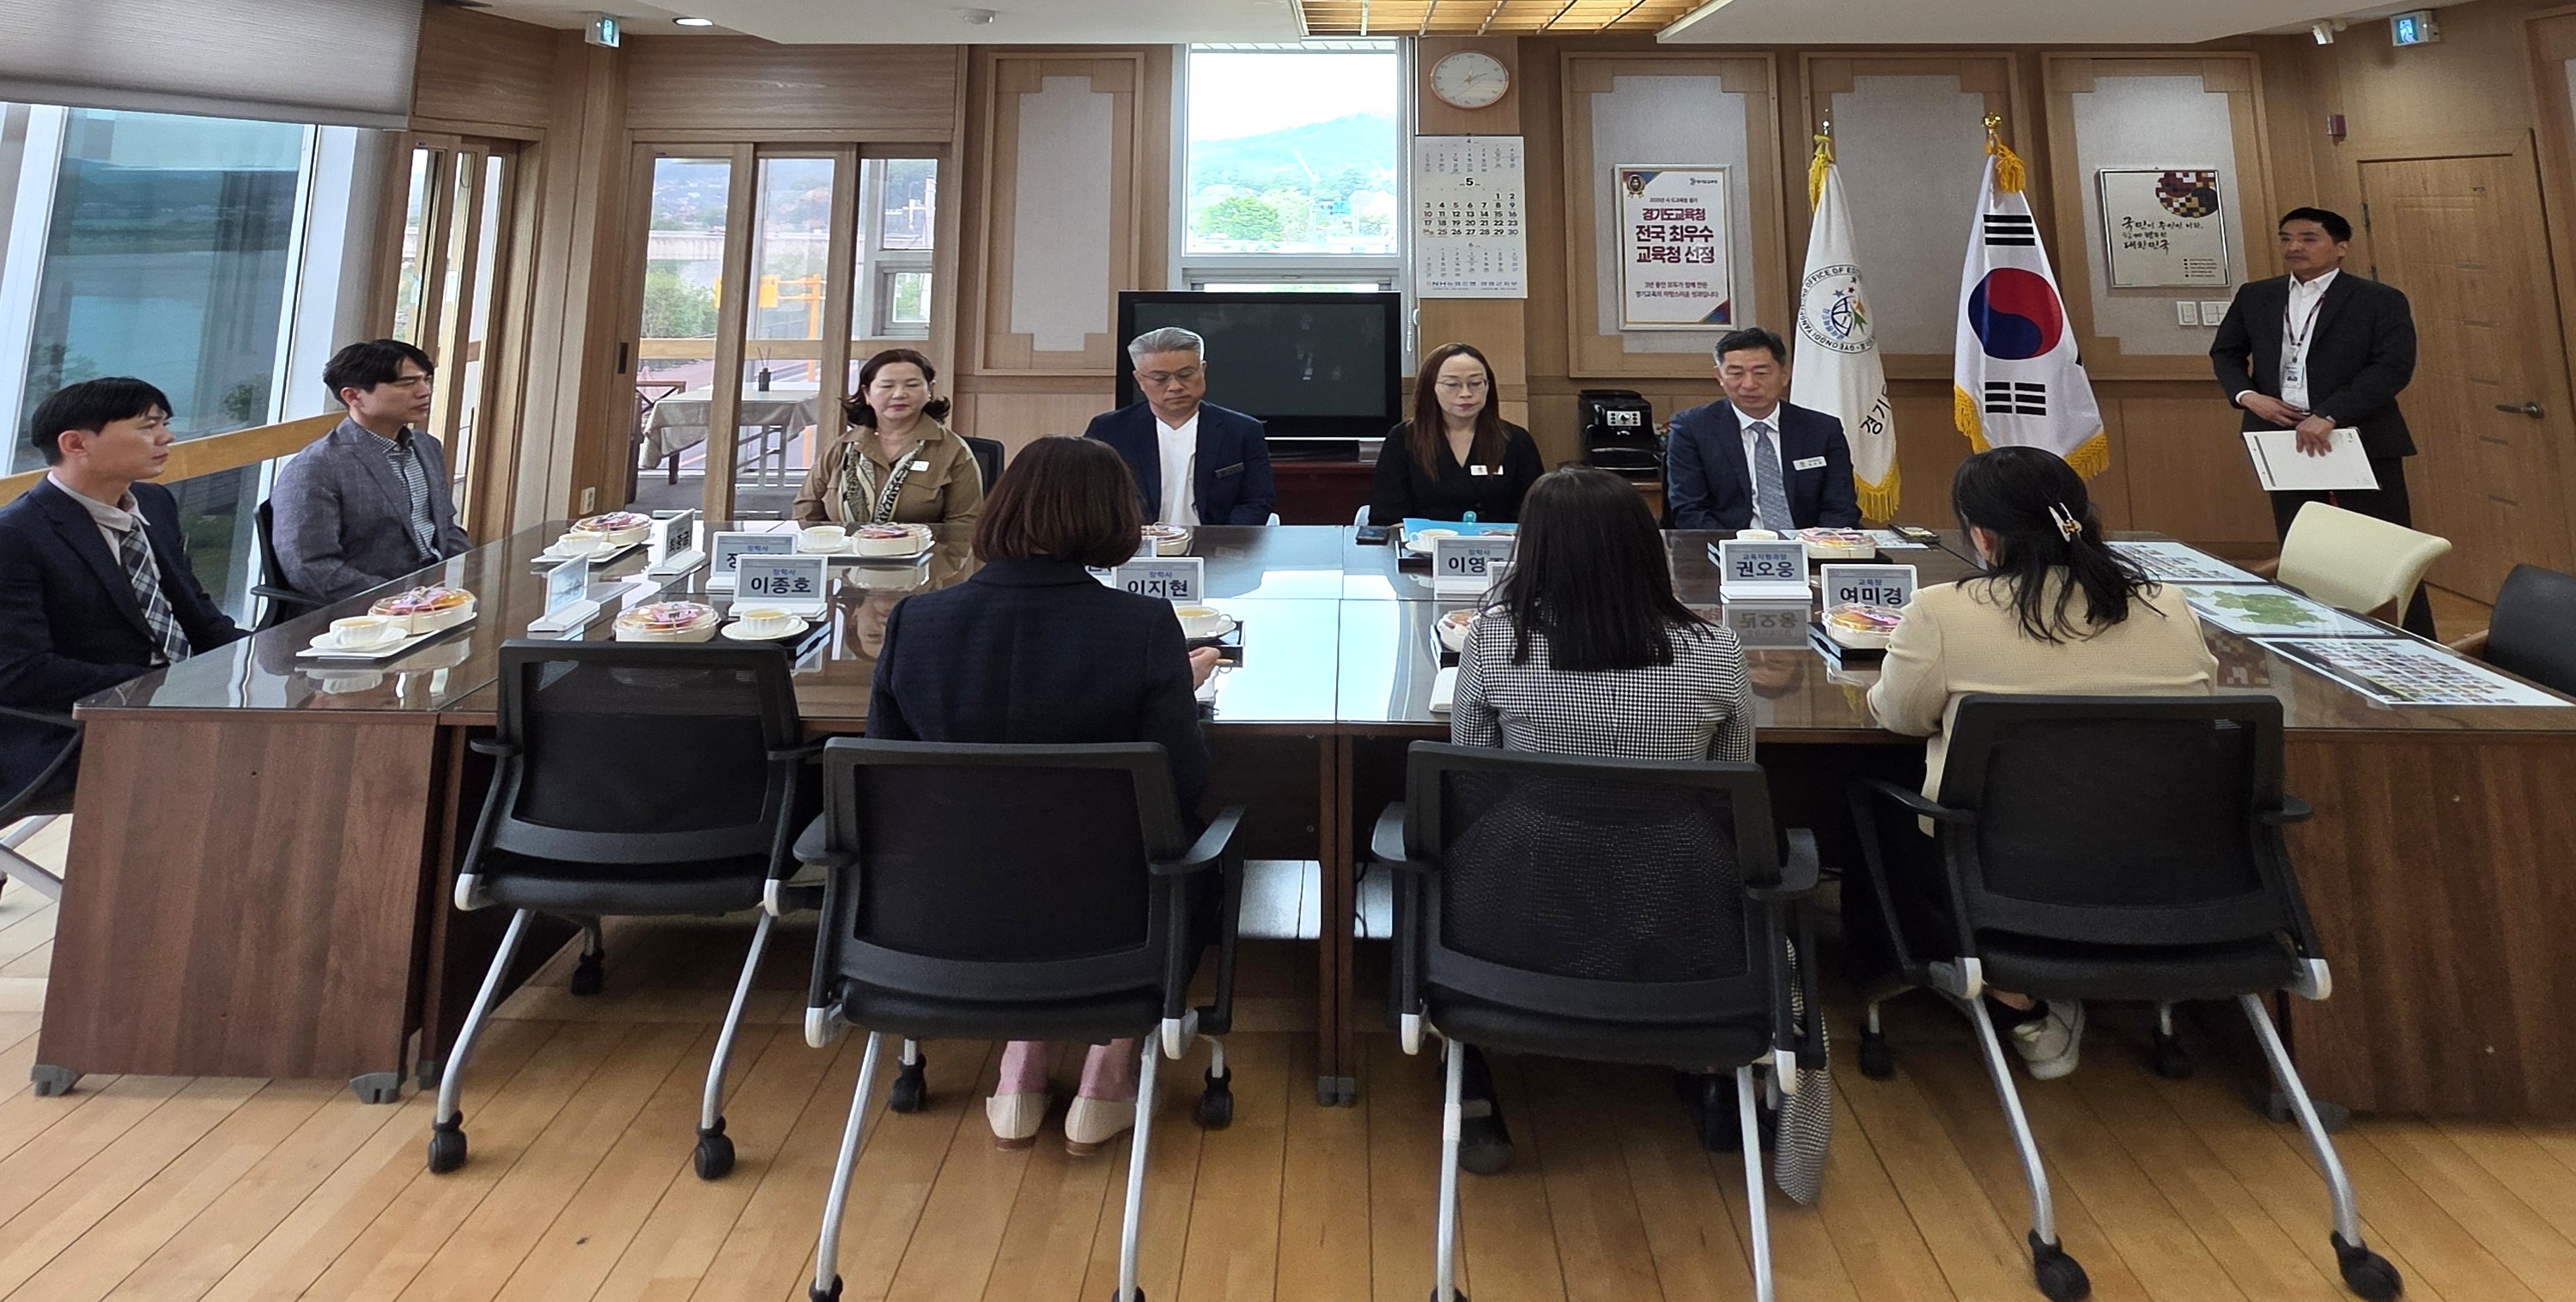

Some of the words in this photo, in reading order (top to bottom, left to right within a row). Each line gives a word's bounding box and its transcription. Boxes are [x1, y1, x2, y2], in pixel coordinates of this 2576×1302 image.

[1643, 208, 1705, 221] 경기도교육청
[2122, 216, 2154, 232] 국민이
[1636, 225, 1665, 242] 전국
[1669, 225, 1714, 242] 최우수
[1636, 246, 1680, 264] 교육청
[1685, 246, 1715, 264] 선정
[2123, 239, 2170, 255] 대한민국
[1806, 270, 1831, 288] OFFICE
[1449, 557, 1504, 573] 이영
[1736, 561, 1795, 577] 권오웅
[750, 576, 811, 594] 이종호
[1127, 580, 1188, 597] 이지현
[1840, 587, 1902, 605] 여미경
